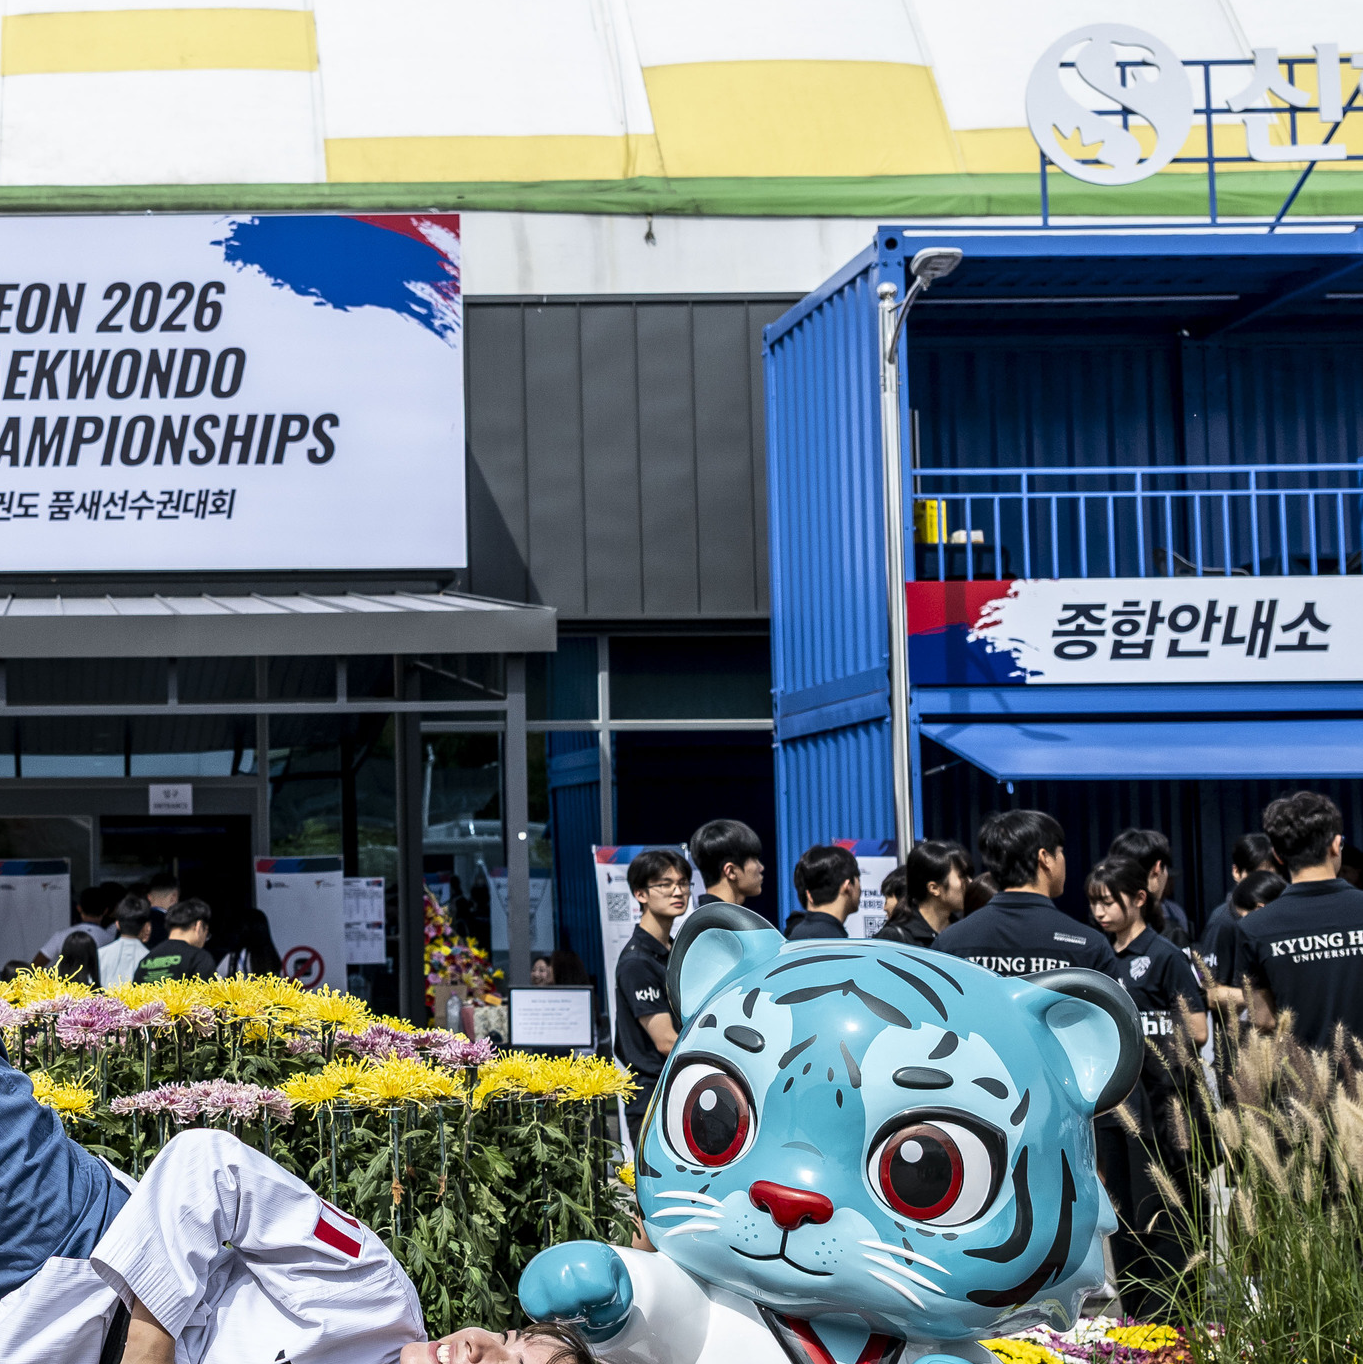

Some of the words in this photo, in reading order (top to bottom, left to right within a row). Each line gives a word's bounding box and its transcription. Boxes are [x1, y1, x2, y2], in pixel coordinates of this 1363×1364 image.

[1226, 43, 1363, 162] 신
[94, 280, 226, 334] 2026
[48, 489, 237, 521] 품새선수권대회
[1051, 599, 1332, 661] 종합안내소
[1269, 932, 1344, 957] KYUNG
[635, 987, 660, 1002] KHU
